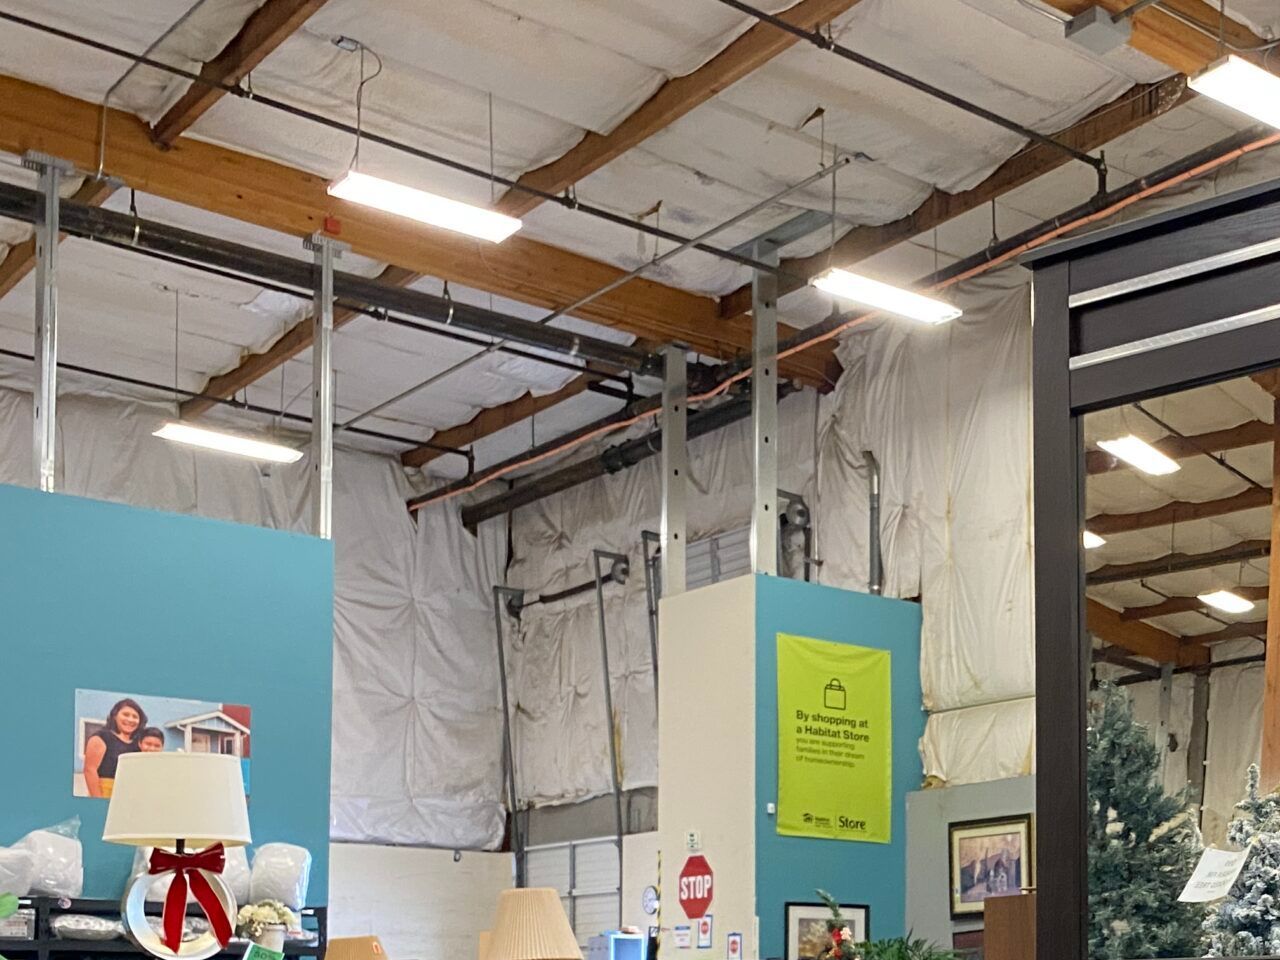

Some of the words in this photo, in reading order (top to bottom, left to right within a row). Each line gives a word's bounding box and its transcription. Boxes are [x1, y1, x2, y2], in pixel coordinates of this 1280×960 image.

[796, 710, 809, 722] By
[812, 713, 856, 729] shopping
[859, 719, 869, 728] at
[796, 726, 802, 734] a
[805, 725, 841, 739] Habitat
[843, 730, 870, 742] Store
[838, 815, 866, 830] Store
[680, 875, 712, 900] STOP
